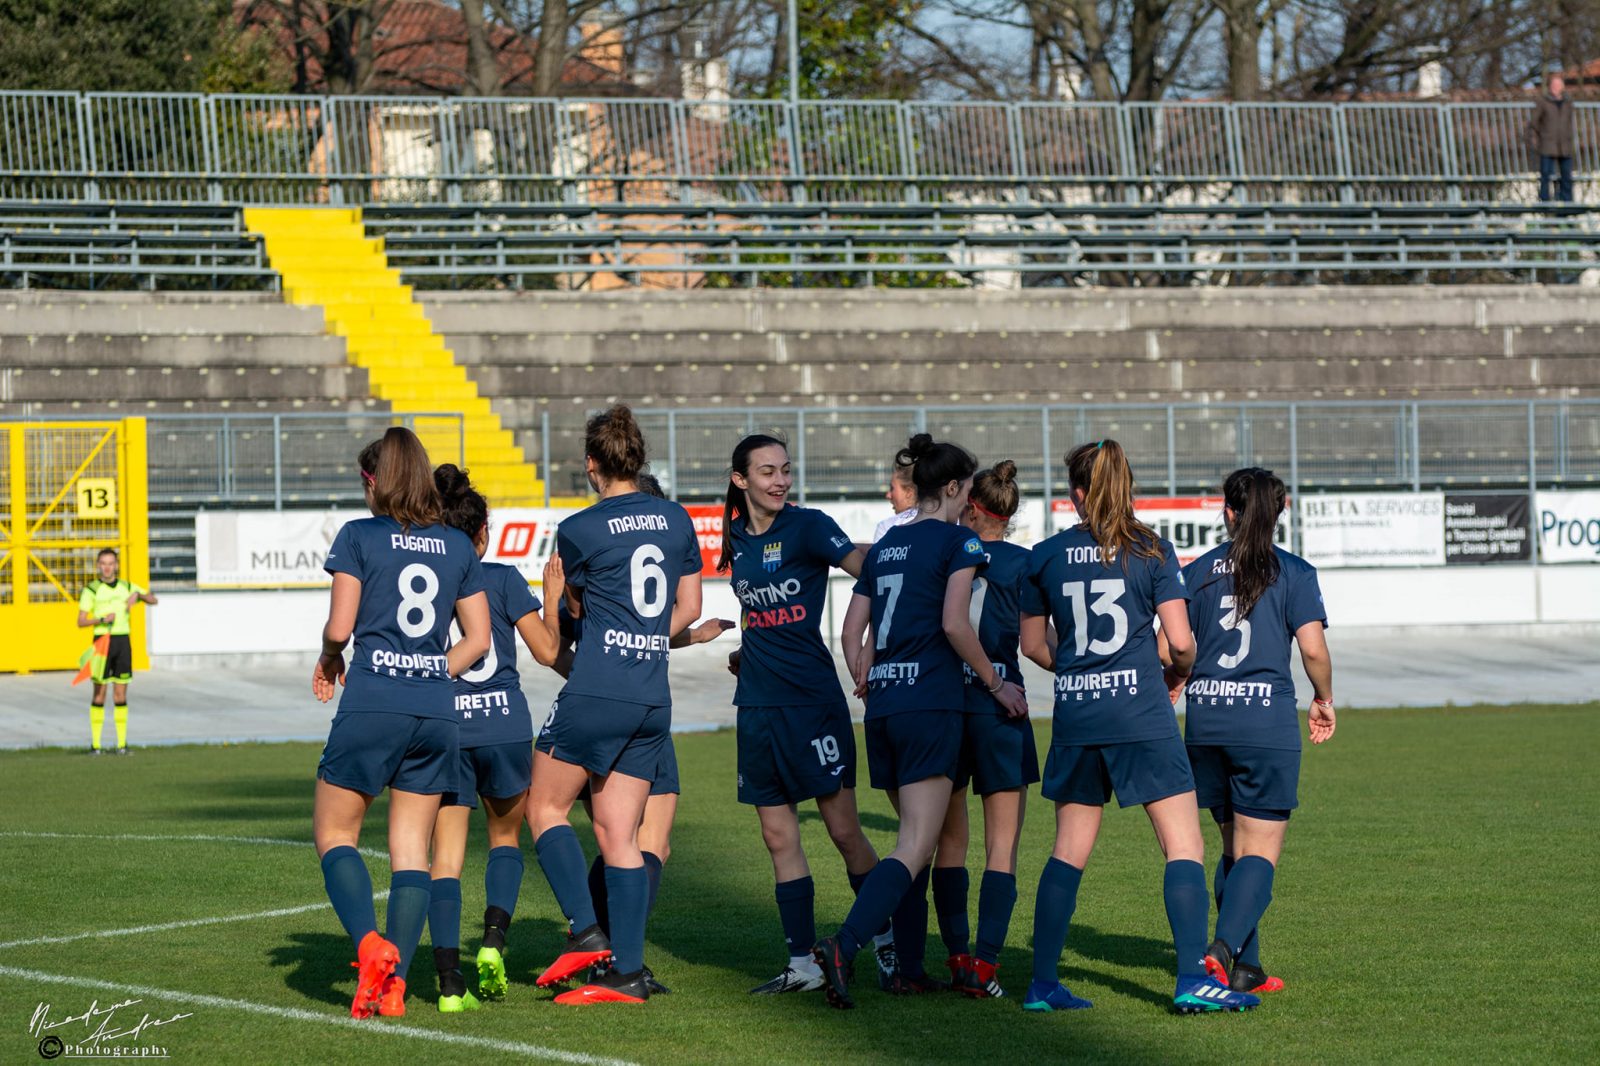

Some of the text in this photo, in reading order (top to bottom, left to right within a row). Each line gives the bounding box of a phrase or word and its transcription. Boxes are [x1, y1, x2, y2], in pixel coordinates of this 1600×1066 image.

[82, 488, 109, 509] 13
[1305, 498, 1440, 516] BETA SERVICES
[607, 514, 669, 535] MAURINA
[390, 533, 447, 555] FUGANTI
[630, 543, 668, 618] 6
[396, 562, 440, 639] 8
[876, 573, 904, 651] 7
[1062, 578, 1129, 657] 13
[1218, 594, 1252, 670] 3
[1188, 679, 1273, 698] COLDIRETTI
[810, 734, 841, 767] 19
